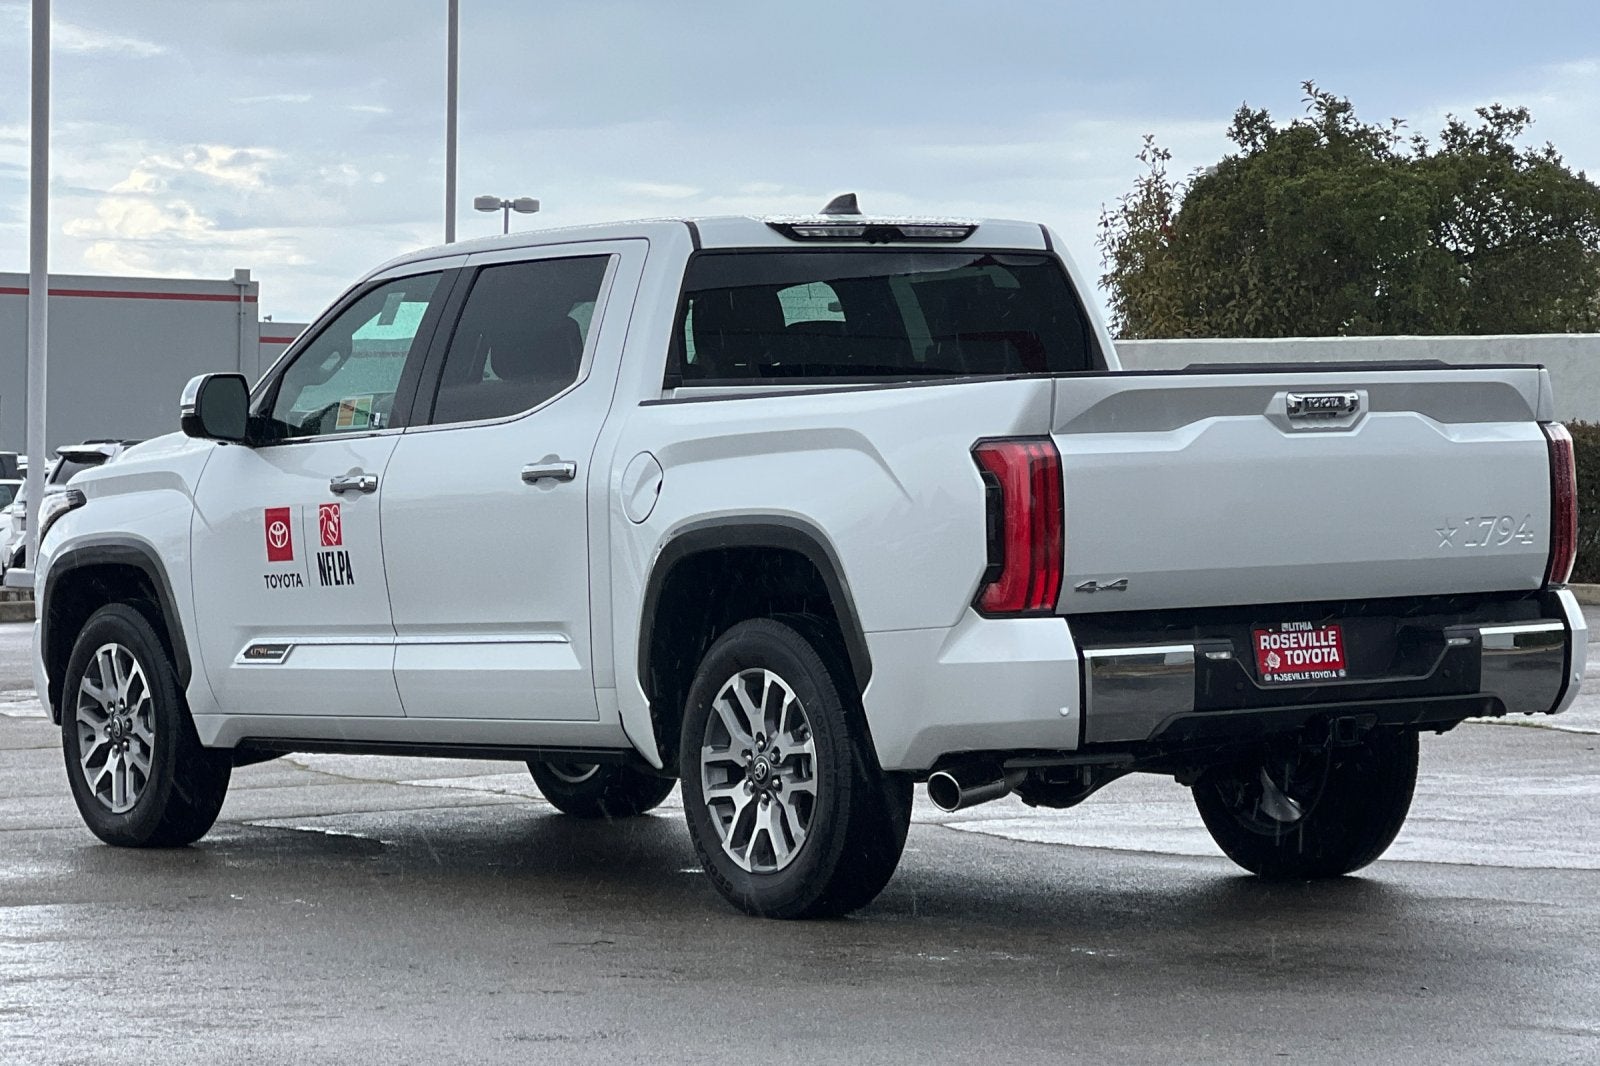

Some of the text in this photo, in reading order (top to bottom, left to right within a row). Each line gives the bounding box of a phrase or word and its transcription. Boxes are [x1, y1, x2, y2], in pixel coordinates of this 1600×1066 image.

[1307, 397, 1341, 408] TOYOTA
[1464, 514, 1534, 547] 1794
[317, 550, 355, 586] NFLPA
[264, 573, 304, 589] TOYOTA
[1289, 621, 1313, 631] LITHIA
[1260, 631, 1337, 650] ROSEVILLE
[1284, 647, 1340, 665] TOYOTA
[1273, 670, 1337, 682] ROSEVILLE TOYOTA
